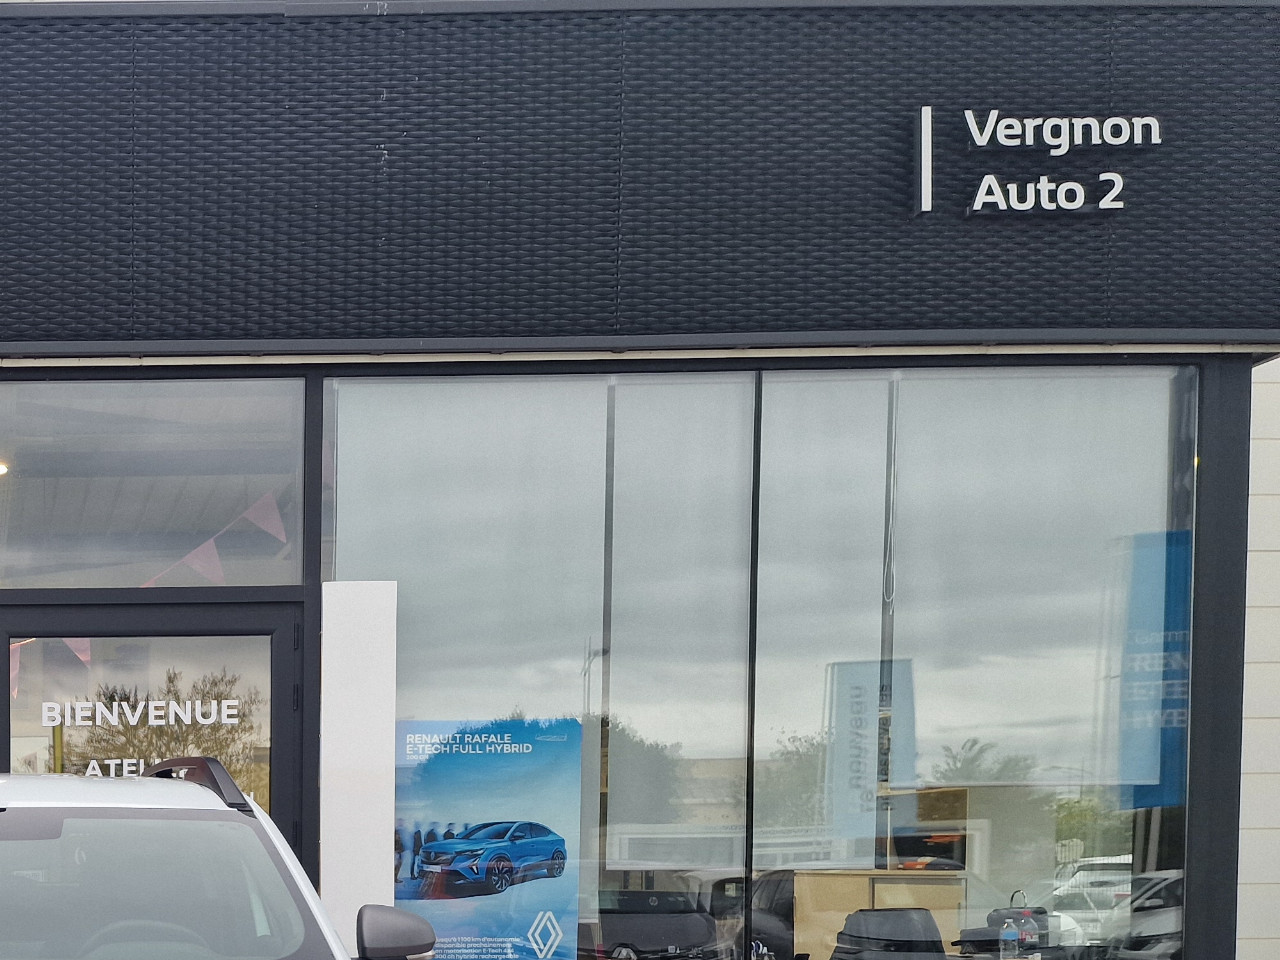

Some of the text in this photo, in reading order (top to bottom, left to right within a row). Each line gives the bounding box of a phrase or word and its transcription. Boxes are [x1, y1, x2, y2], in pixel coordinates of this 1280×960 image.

[964, 109, 1162, 157] Vergnon
[972, 172, 1125, 210] Auto 2
[41, 700, 240, 728] BIENVENUE
[406, 733, 512, 744] RENAULT RAFALE
[406, 743, 532, 754] E-TECH FULL HYBRID
